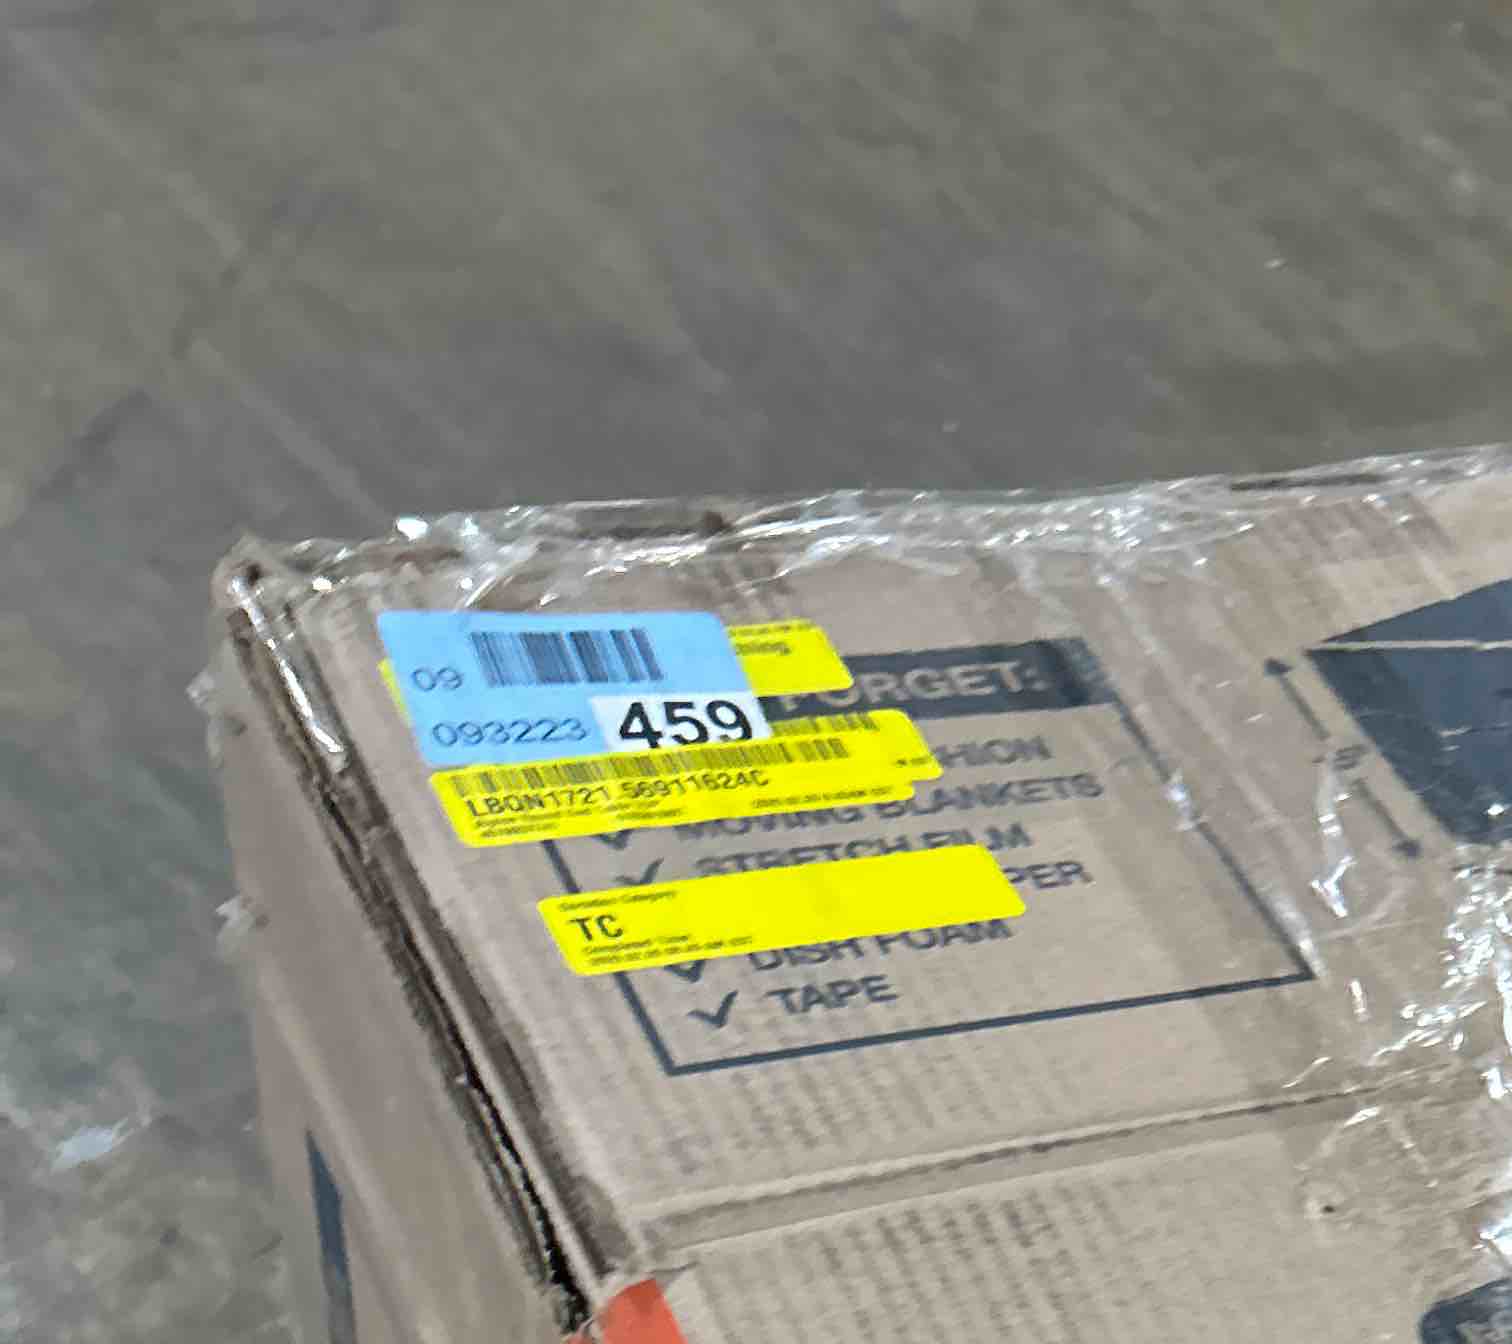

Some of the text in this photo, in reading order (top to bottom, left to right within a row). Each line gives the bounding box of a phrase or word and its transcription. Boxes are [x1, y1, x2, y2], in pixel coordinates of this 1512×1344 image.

[410, 666, 463, 692] 09
[431, 700, 754, 749] 093223 459
[568, 913, 625, 943] TC
[765, 973, 900, 1015] TAPE
